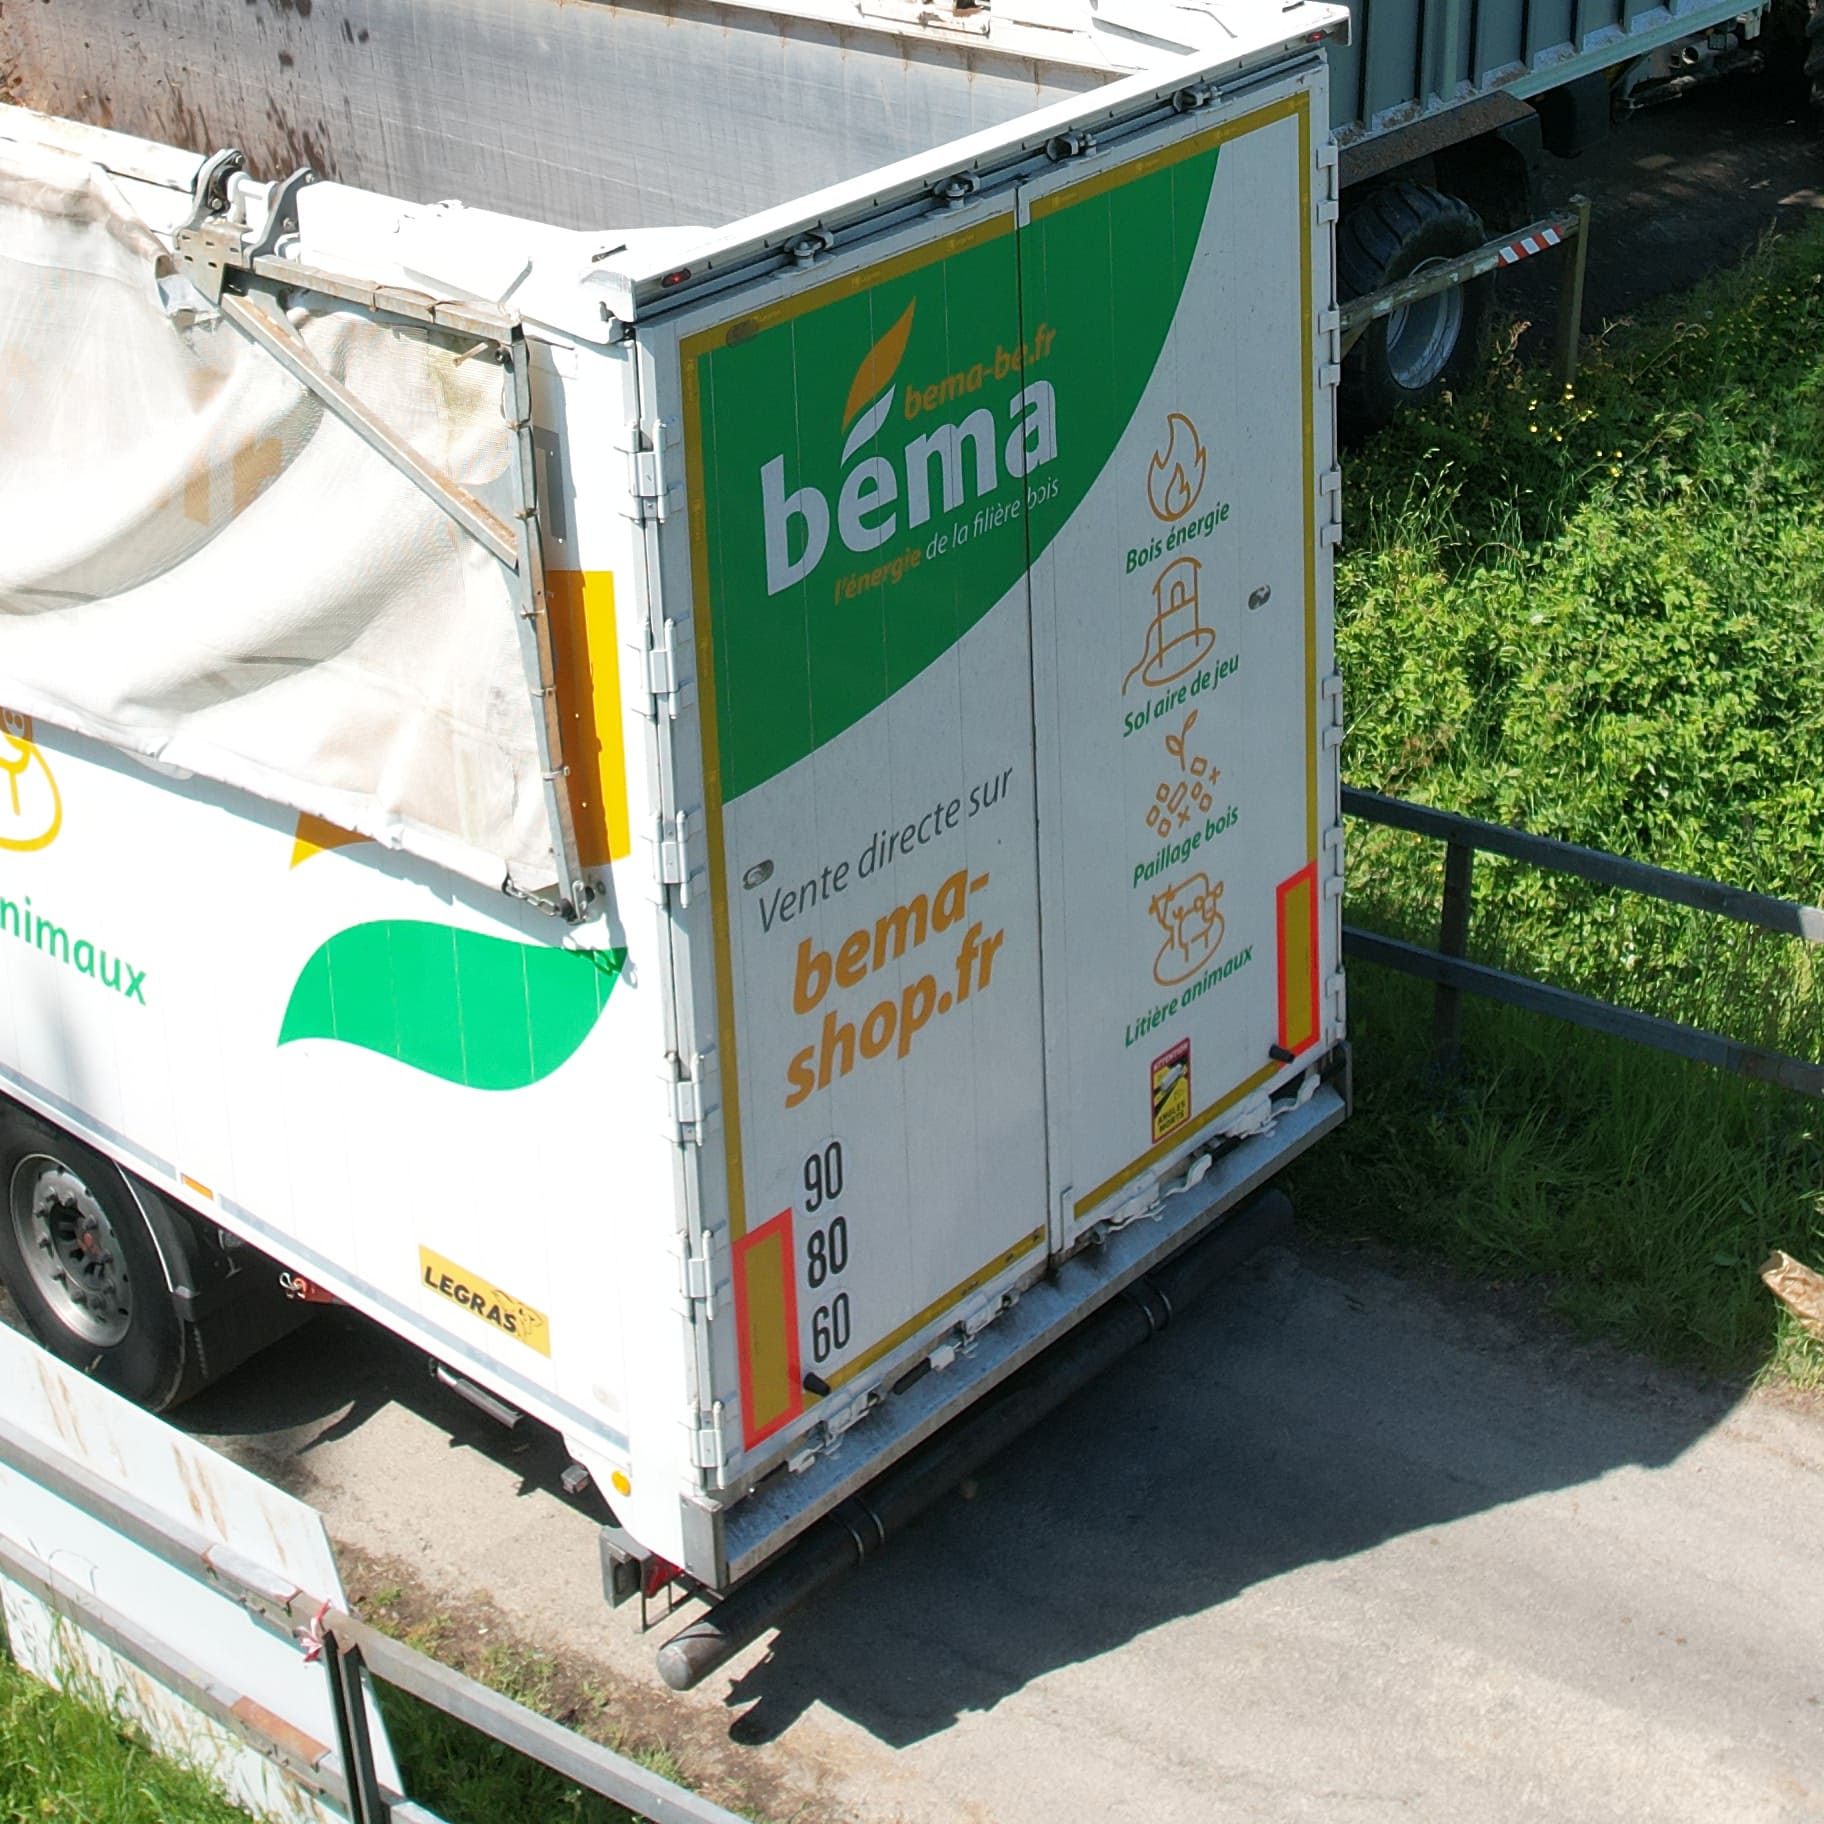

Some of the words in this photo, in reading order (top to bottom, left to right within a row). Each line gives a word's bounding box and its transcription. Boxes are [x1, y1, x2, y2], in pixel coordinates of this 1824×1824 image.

[904, 322, 1056, 421] bema-be.fr
[760, 379, 1058, 597] béma
[834, 547, 921, 607] l'énergie
[926, 532, 948, 561] de
[952, 523, 968, 549] la
[973, 501, 1021, 539] filière
[1027, 477, 1059, 511] bois
[1125, 537, 1163, 575] Bois
[1166, 501, 1230, 552] énergie
[1123, 701, 1151, 738] Sol
[1153, 685, 1187, 722] aire
[1190, 669, 1211, 697] de
[1212, 654, 1240, 690] jeu
[758, 861, 850, 934] Vente
[858, 797, 961, 879] directe
[968, 767, 1013, 818] sur
[1133, 830, 1201, 889] Paillage
[1204, 805, 1239, 843] bois
[792, 868, 990, 1016] bema-
[784, 921, 1005, 1109] shop.fr
[1125, 998, 1179, 1049] Litière
[1180, 944, 1254, 1008] animaux
[803, 1141, 844, 1213] 90
[807, 1215, 849, 1289] 80
[424, 1266, 517, 1334] LEGRAS
[811, 1292, 851, 1364] 60
